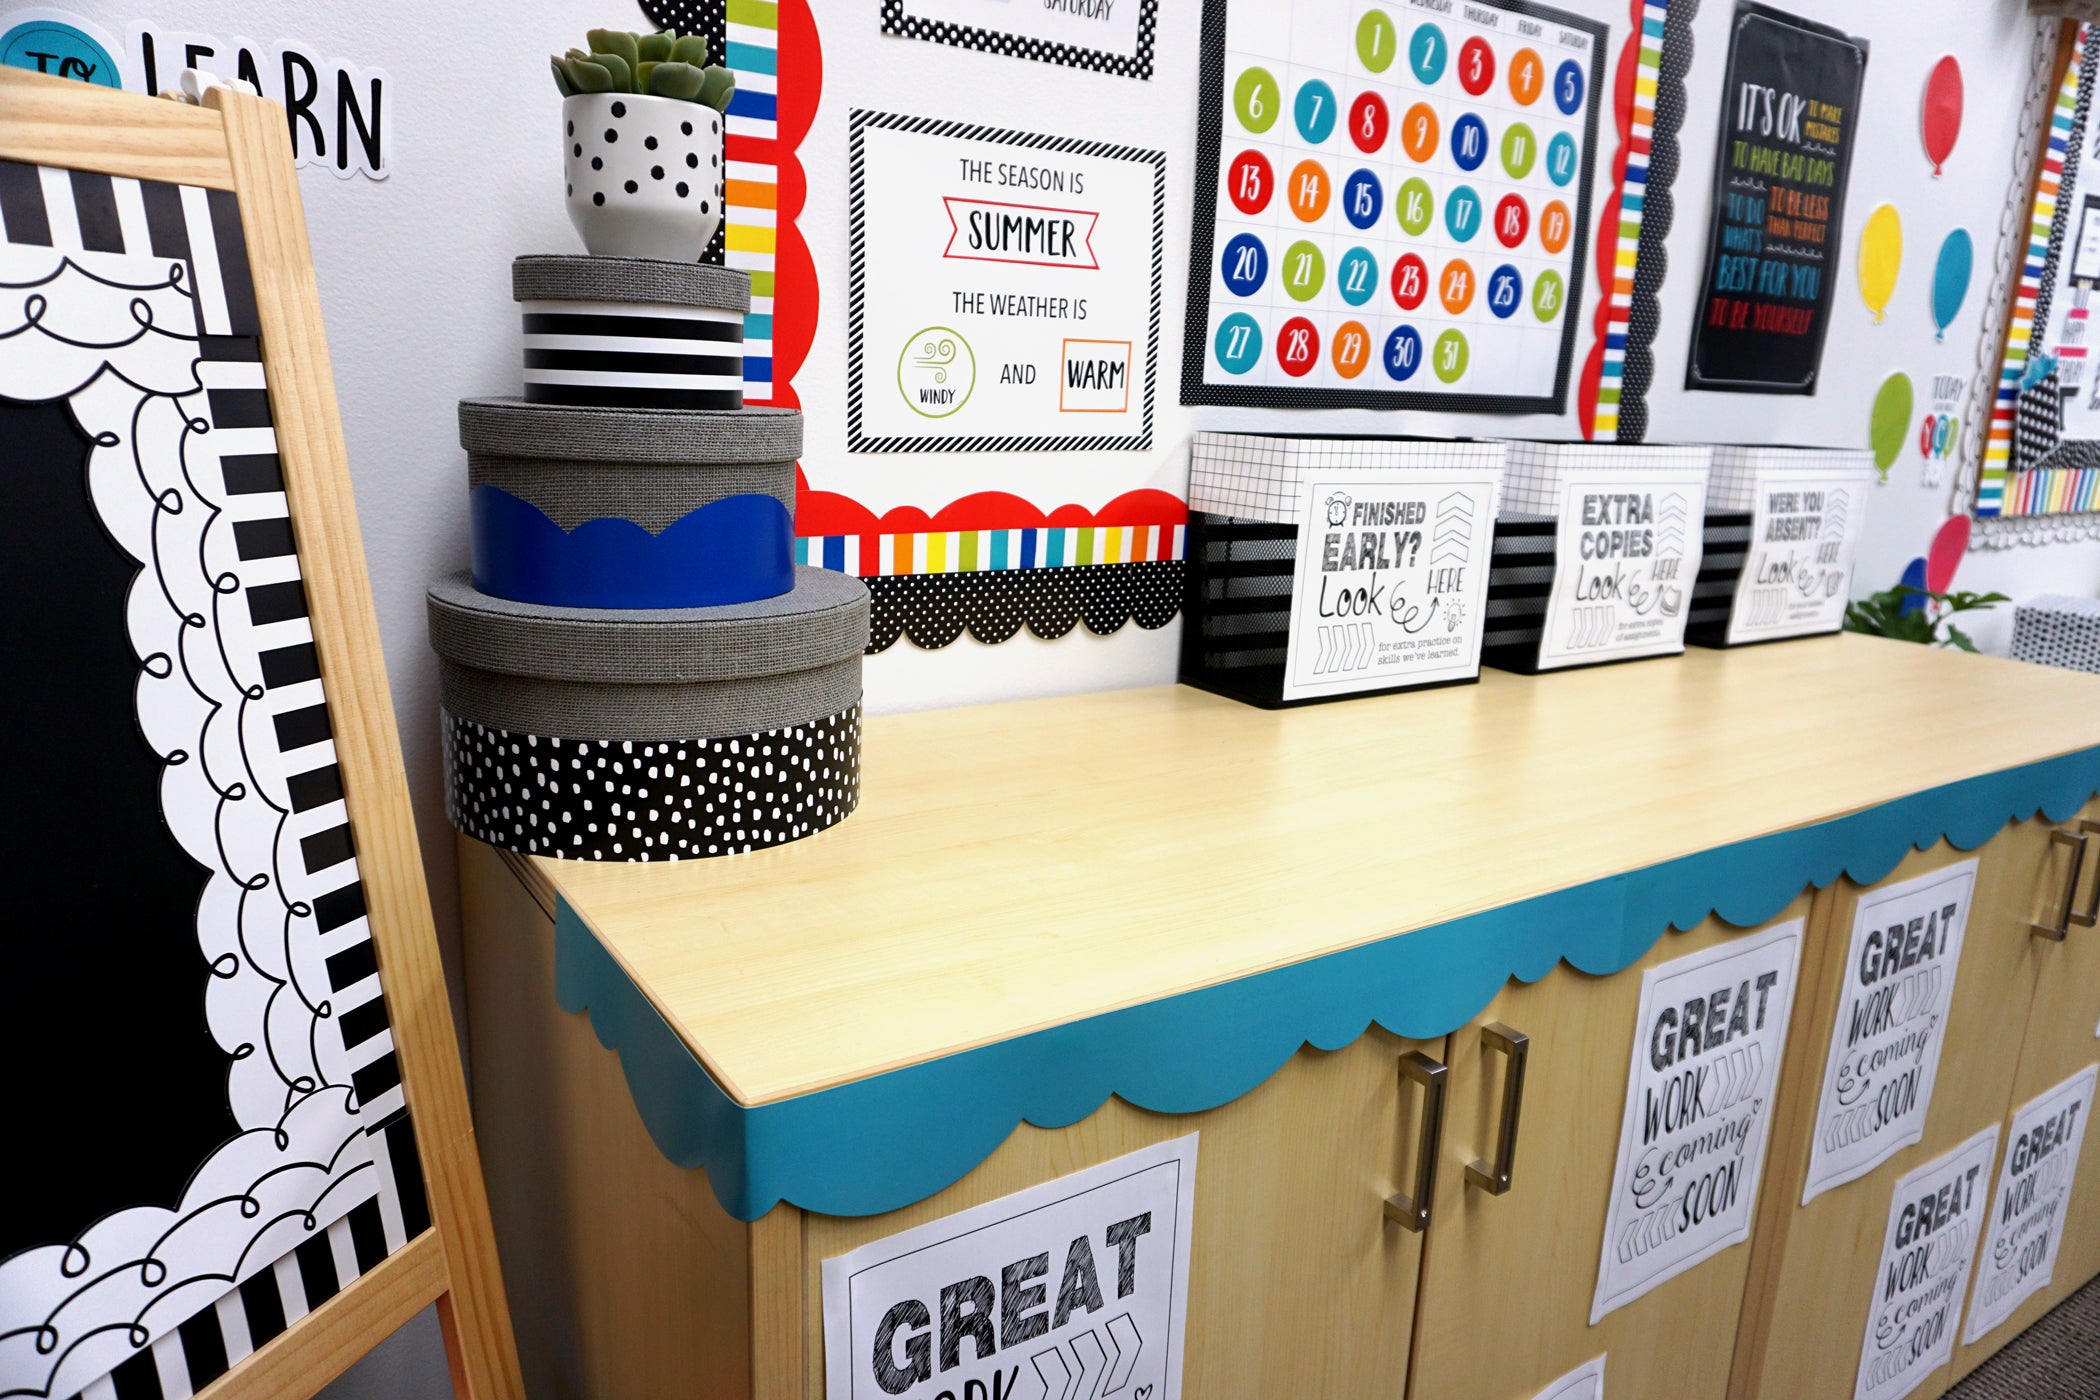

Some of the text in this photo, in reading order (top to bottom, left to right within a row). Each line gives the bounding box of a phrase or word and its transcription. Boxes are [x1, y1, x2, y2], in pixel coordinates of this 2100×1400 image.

[1410, 0, 1452, 14] NESDAY
[1463, 5, 1499, 27] THURSDAY
[1518, 19, 1543, 38] FRIDAY
[1372, 24, 1574, 103] 1 2 3 4 5
[142, 32, 382, 171] LRN
[1737, 82, 1807, 144] IT'S OK
[1249, 83, 1570, 175] 6 7 8 9 10 11 12
[1804, 121, 1840, 144] MISTAKES
[960, 158, 1084, 194] THE SEASON IS
[1732, 141, 1835, 188] TO HAVE BAD DAYS
[1239, 164, 1564, 241] 13 14 15 16 17 18 19
[1727, 192, 1765, 224] TO DO
[1769, 186, 1829, 221] TO BE LESS
[968, 210, 1077, 257] SUMMER
[1723, 225, 1763, 254] WHAT'S
[1767, 215, 1827, 243] THAN PERFECT
[1233, 246, 1557, 310] 20 21 22 23 24 25 26
[1716, 255, 1821, 300] BEST FOR YOU
[952, 291, 1087, 320] THE WEATHER IS
[1708, 297, 1814, 335] TO BE YOURSELF
[1226, 325, 1459, 370] 27 28 29 30 31
[920, 388, 956, 405] WINDY
[1000, 359, 1125, 390] AND WARM
[1353, 501, 1426, 526] FINISHED
[1581, 494, 1654, 526] EXTRA
[1769, 491, 1825, 514] WERE YOU
[1321, 530, 1422, 572] EARLY?
[1580, 529, 1653, 561] COPIES
[1766, 516, 1822, 542] ABSENT?
[1427, 567, 1466, 594] HERE
[1652, 558, 1682, 581] HERE
[1377, 648, 1459, 665] skills we've learned.
[1378, 636, 1462, 652] for extra practice on
[1860, 902, 1957, 986] GREAT
[1650, 970, 1778, 1072] GREAT
[1848, 982, 1900, 1048] WORK
[1858, 1023, 1929, 1070] coming
[1644, 1065, 1709, 1145] WORK
[1874, 1065, 1922, 1132] SOON
[1659, 1111, 1753, 1175] coming
[2011, 1100, 2081, 1176] GREAT
[1678, 1156, 1744, 1234] SOON
[1895, 1165, 1980, 1250] GREAT
[2003, 1171, 2037, 1224] WORK
[2011, 1200, 2057, 1246] coming
[1885, 1242, 1935, 1302] WORK
[2017, 1233, 2048, 1284] SOON
[872, 1211, 1151, 1394] GREAT
[1895, 1271, 1959, 1318] coming
[1908, 1303, 1950, 1366] SOON
